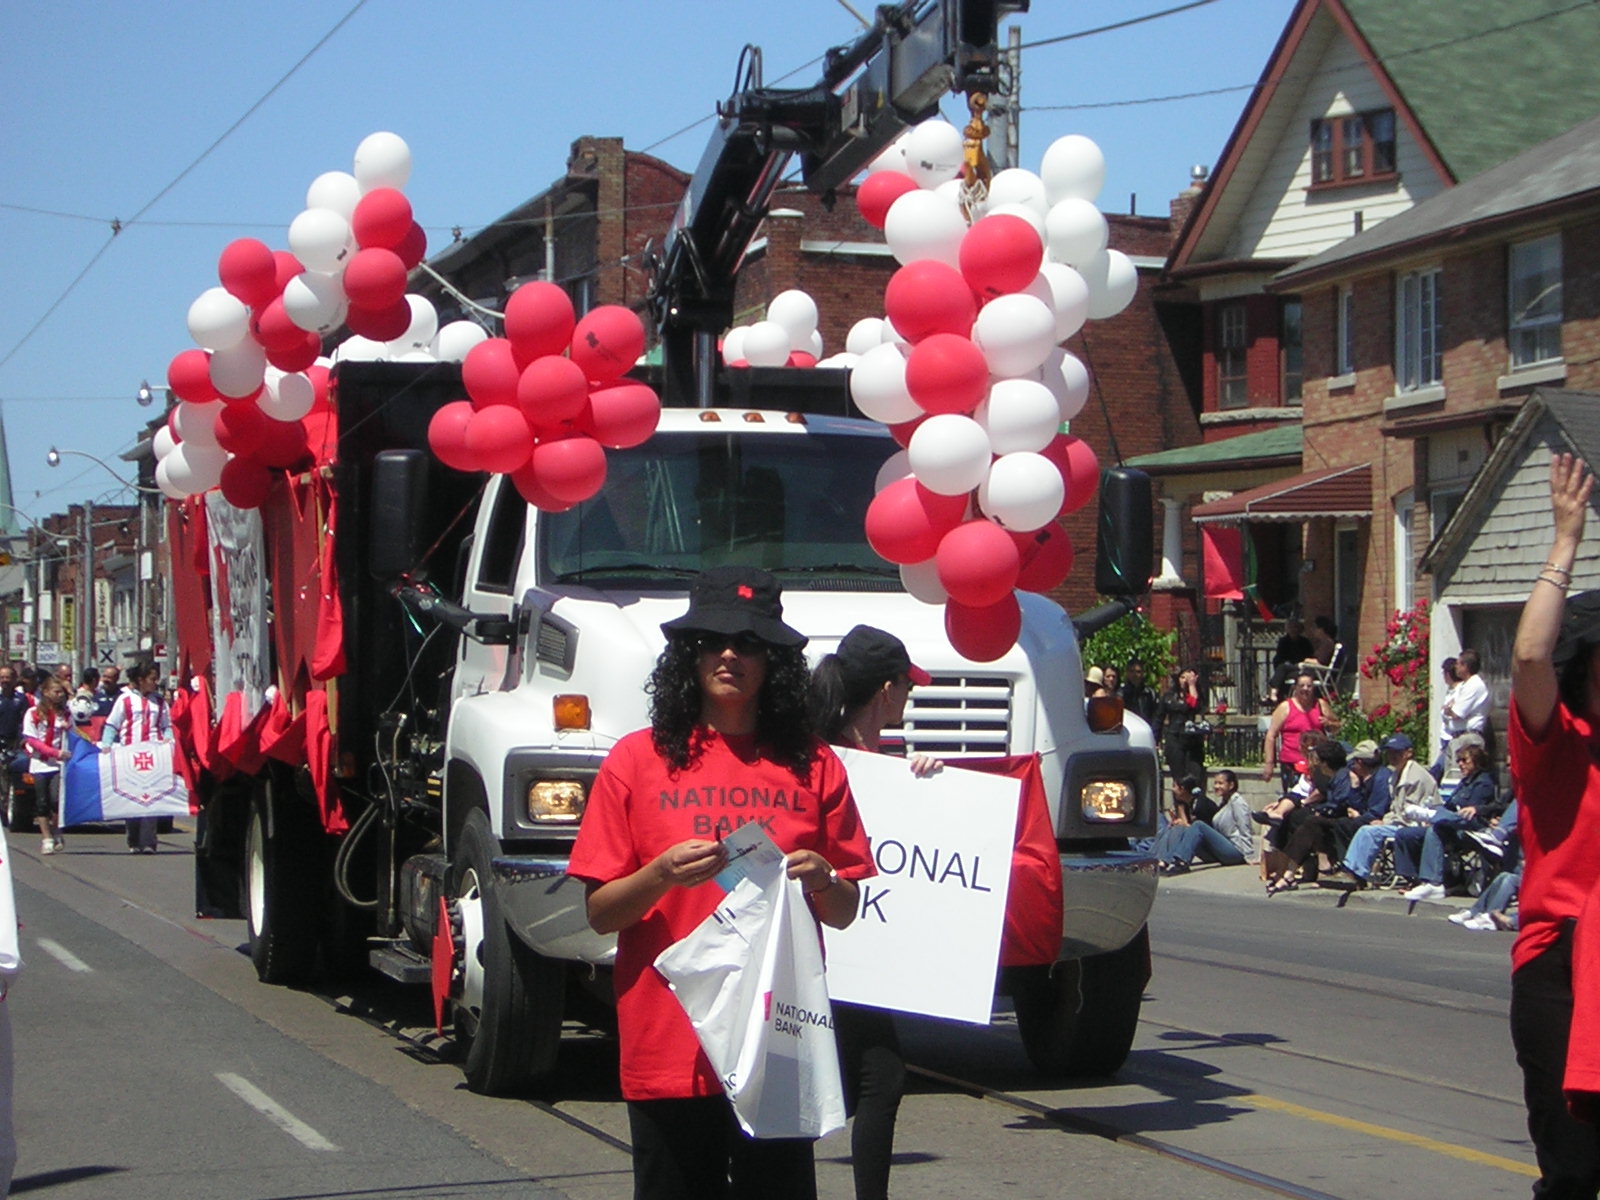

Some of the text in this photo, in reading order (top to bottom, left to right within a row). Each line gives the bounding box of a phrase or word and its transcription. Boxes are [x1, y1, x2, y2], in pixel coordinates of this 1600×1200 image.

[659, 785, 807, 813] NATIONAL
[775, 1001, 835, 1030] NATIONAL
[775, 1018, 803, 1039] BANK
